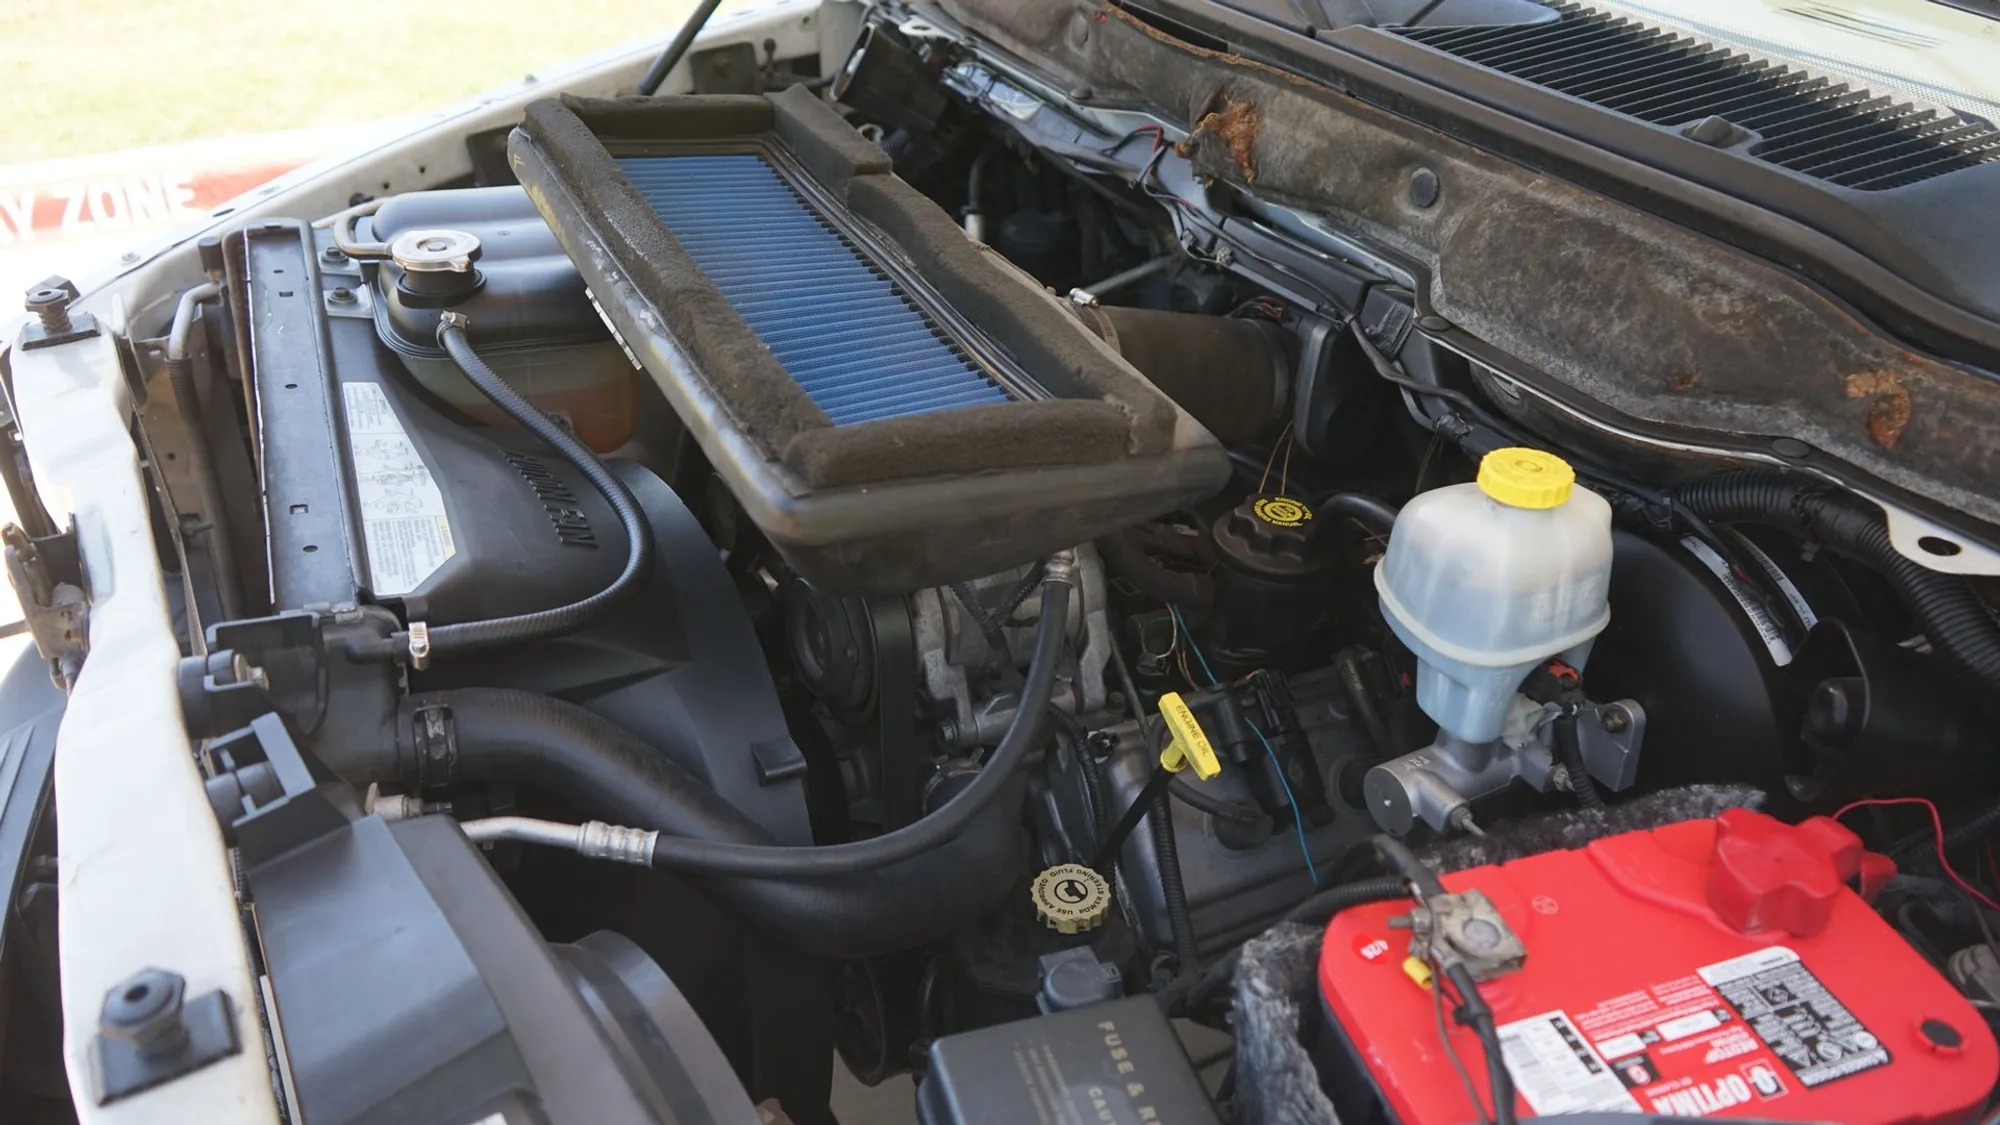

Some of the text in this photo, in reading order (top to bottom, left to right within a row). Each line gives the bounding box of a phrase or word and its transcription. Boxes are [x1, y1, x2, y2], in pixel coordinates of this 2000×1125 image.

[50, 173, 197, 233] ZONE
[1176, 704, 1210, 758] ENGINE OIL
[1038, 878, 1074, 915] USE APPROVED
[1049, 867, 1105, 914] POWER STEERING FLUID
[1097, 1020, 1135, 1074] FUSE
[1126, 1082, 1145, 1098] &
[1651, 1073, 1752, 1116] OPTIMA
